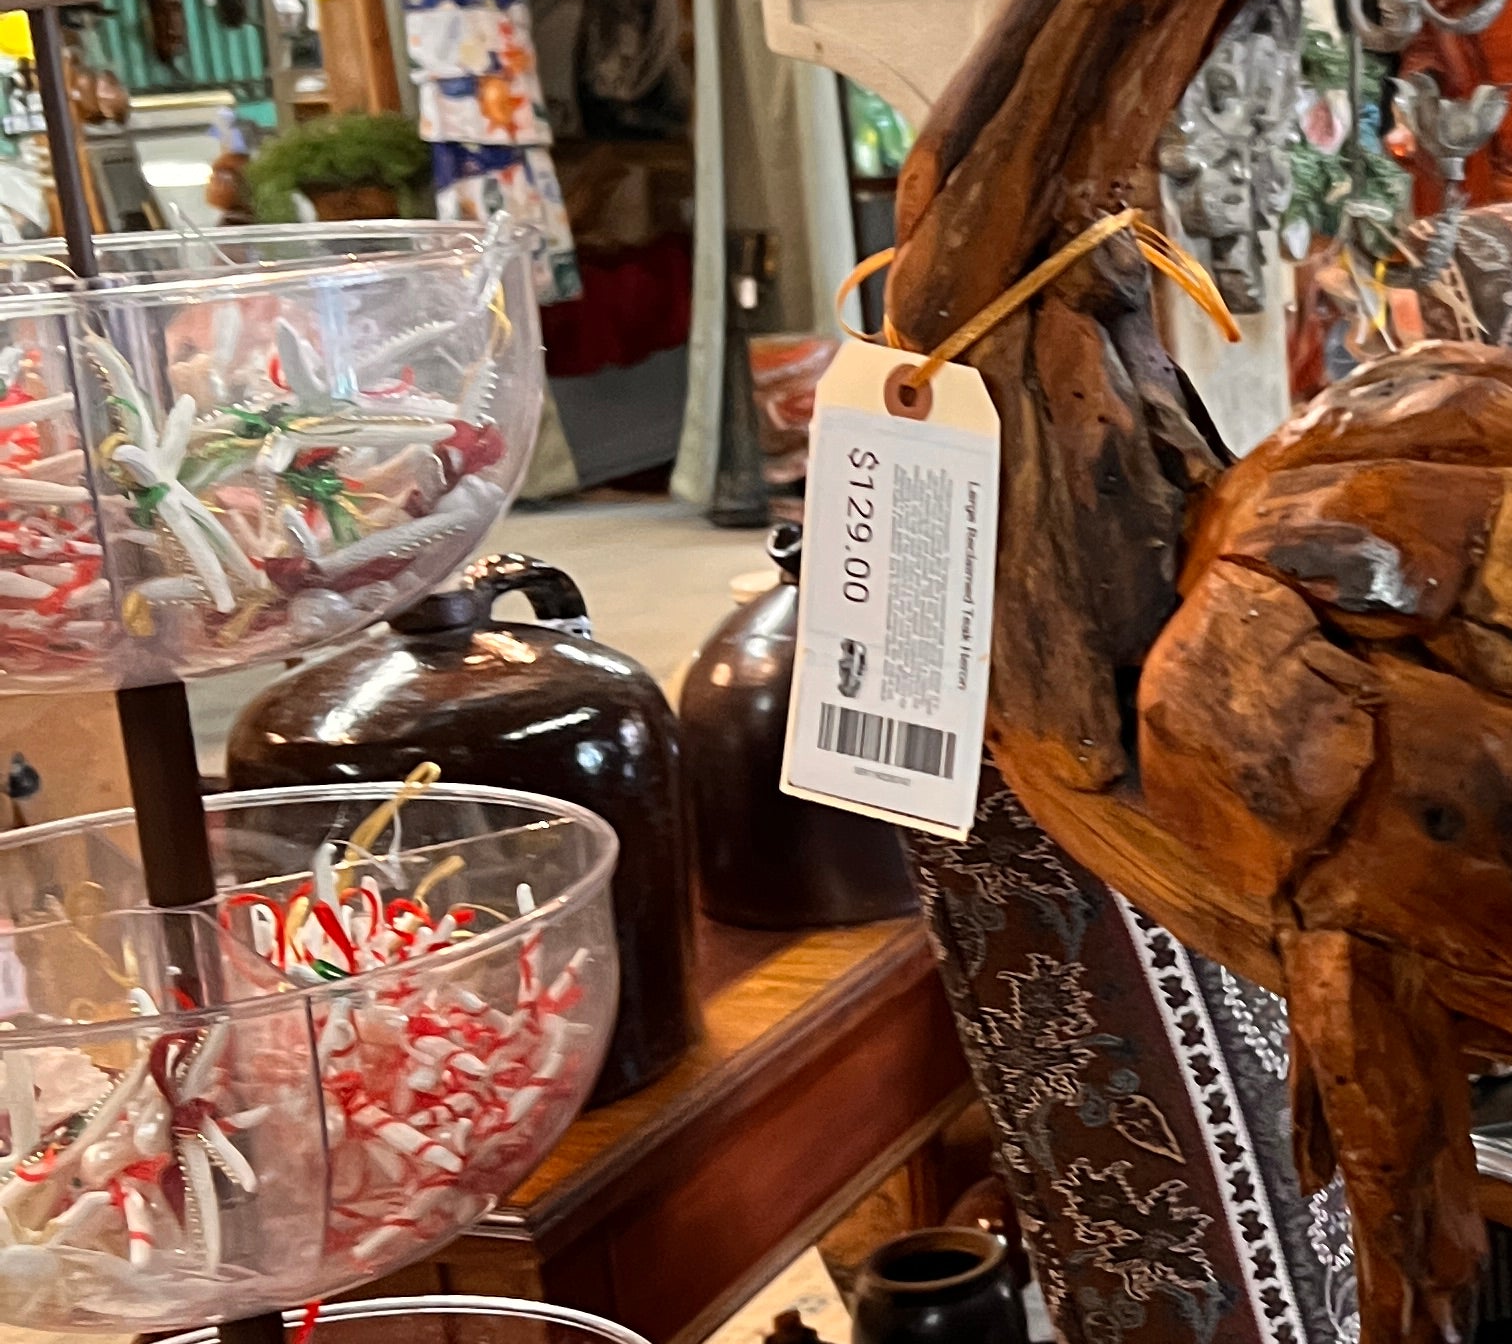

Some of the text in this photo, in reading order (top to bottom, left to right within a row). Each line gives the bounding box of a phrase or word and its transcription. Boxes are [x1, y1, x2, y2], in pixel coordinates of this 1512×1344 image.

[964, 480, 981, 523] Large
[842, 447, 880, 603] $129.00
[960, 609, 975, 642] Teak
[957, 645, 972, 691] Heron
